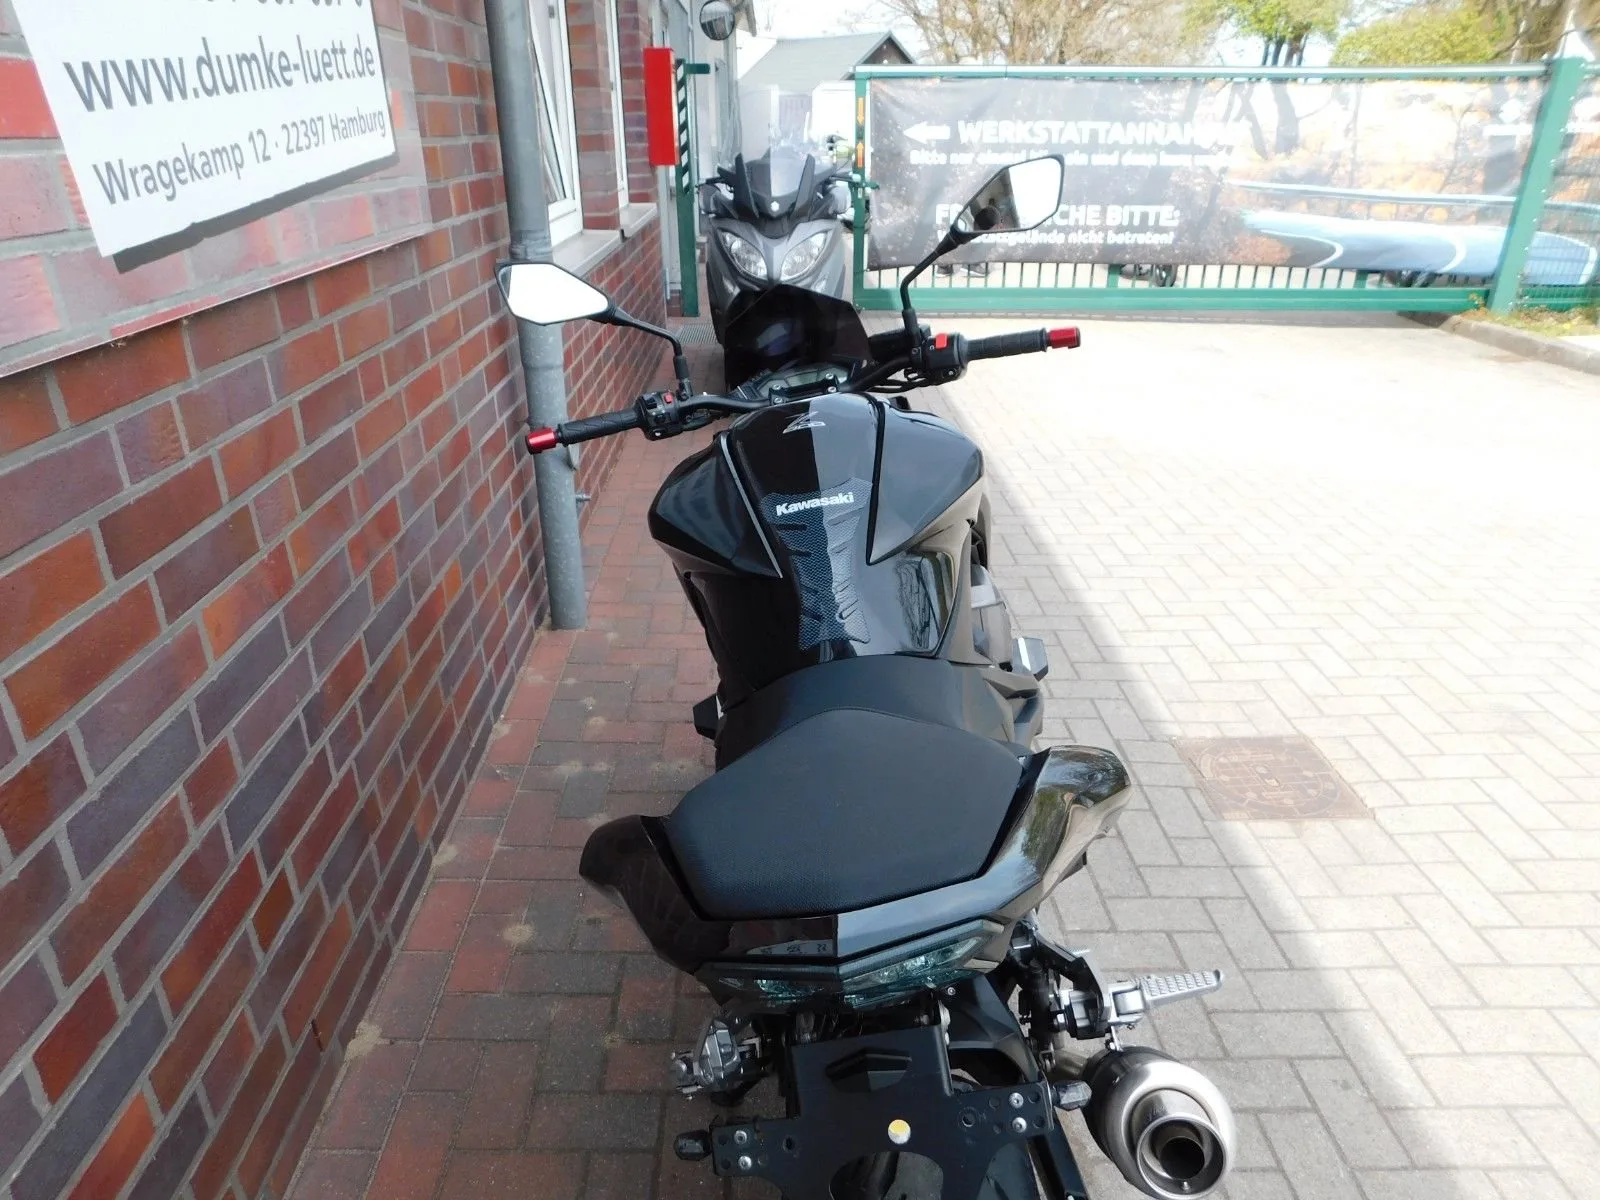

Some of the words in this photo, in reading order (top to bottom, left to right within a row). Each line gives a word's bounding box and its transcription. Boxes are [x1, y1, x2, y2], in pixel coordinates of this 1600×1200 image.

[63, 34, 376, 112] www.dumke-luett.de
[957, 120, 1240, 145] WERKSTATTANNAH
[92, 142, 244, 205] Wragekamp
[248, 128, 271, 164] 12
[281, 115, 326, 155] 22397
[328, 105, 386, 142] Hamburg
[1105, 204, 1180, 227] BITTE:
[1068, 229, 1105, 244] nicht
[776, 491, 855, 516] Kawasaki
